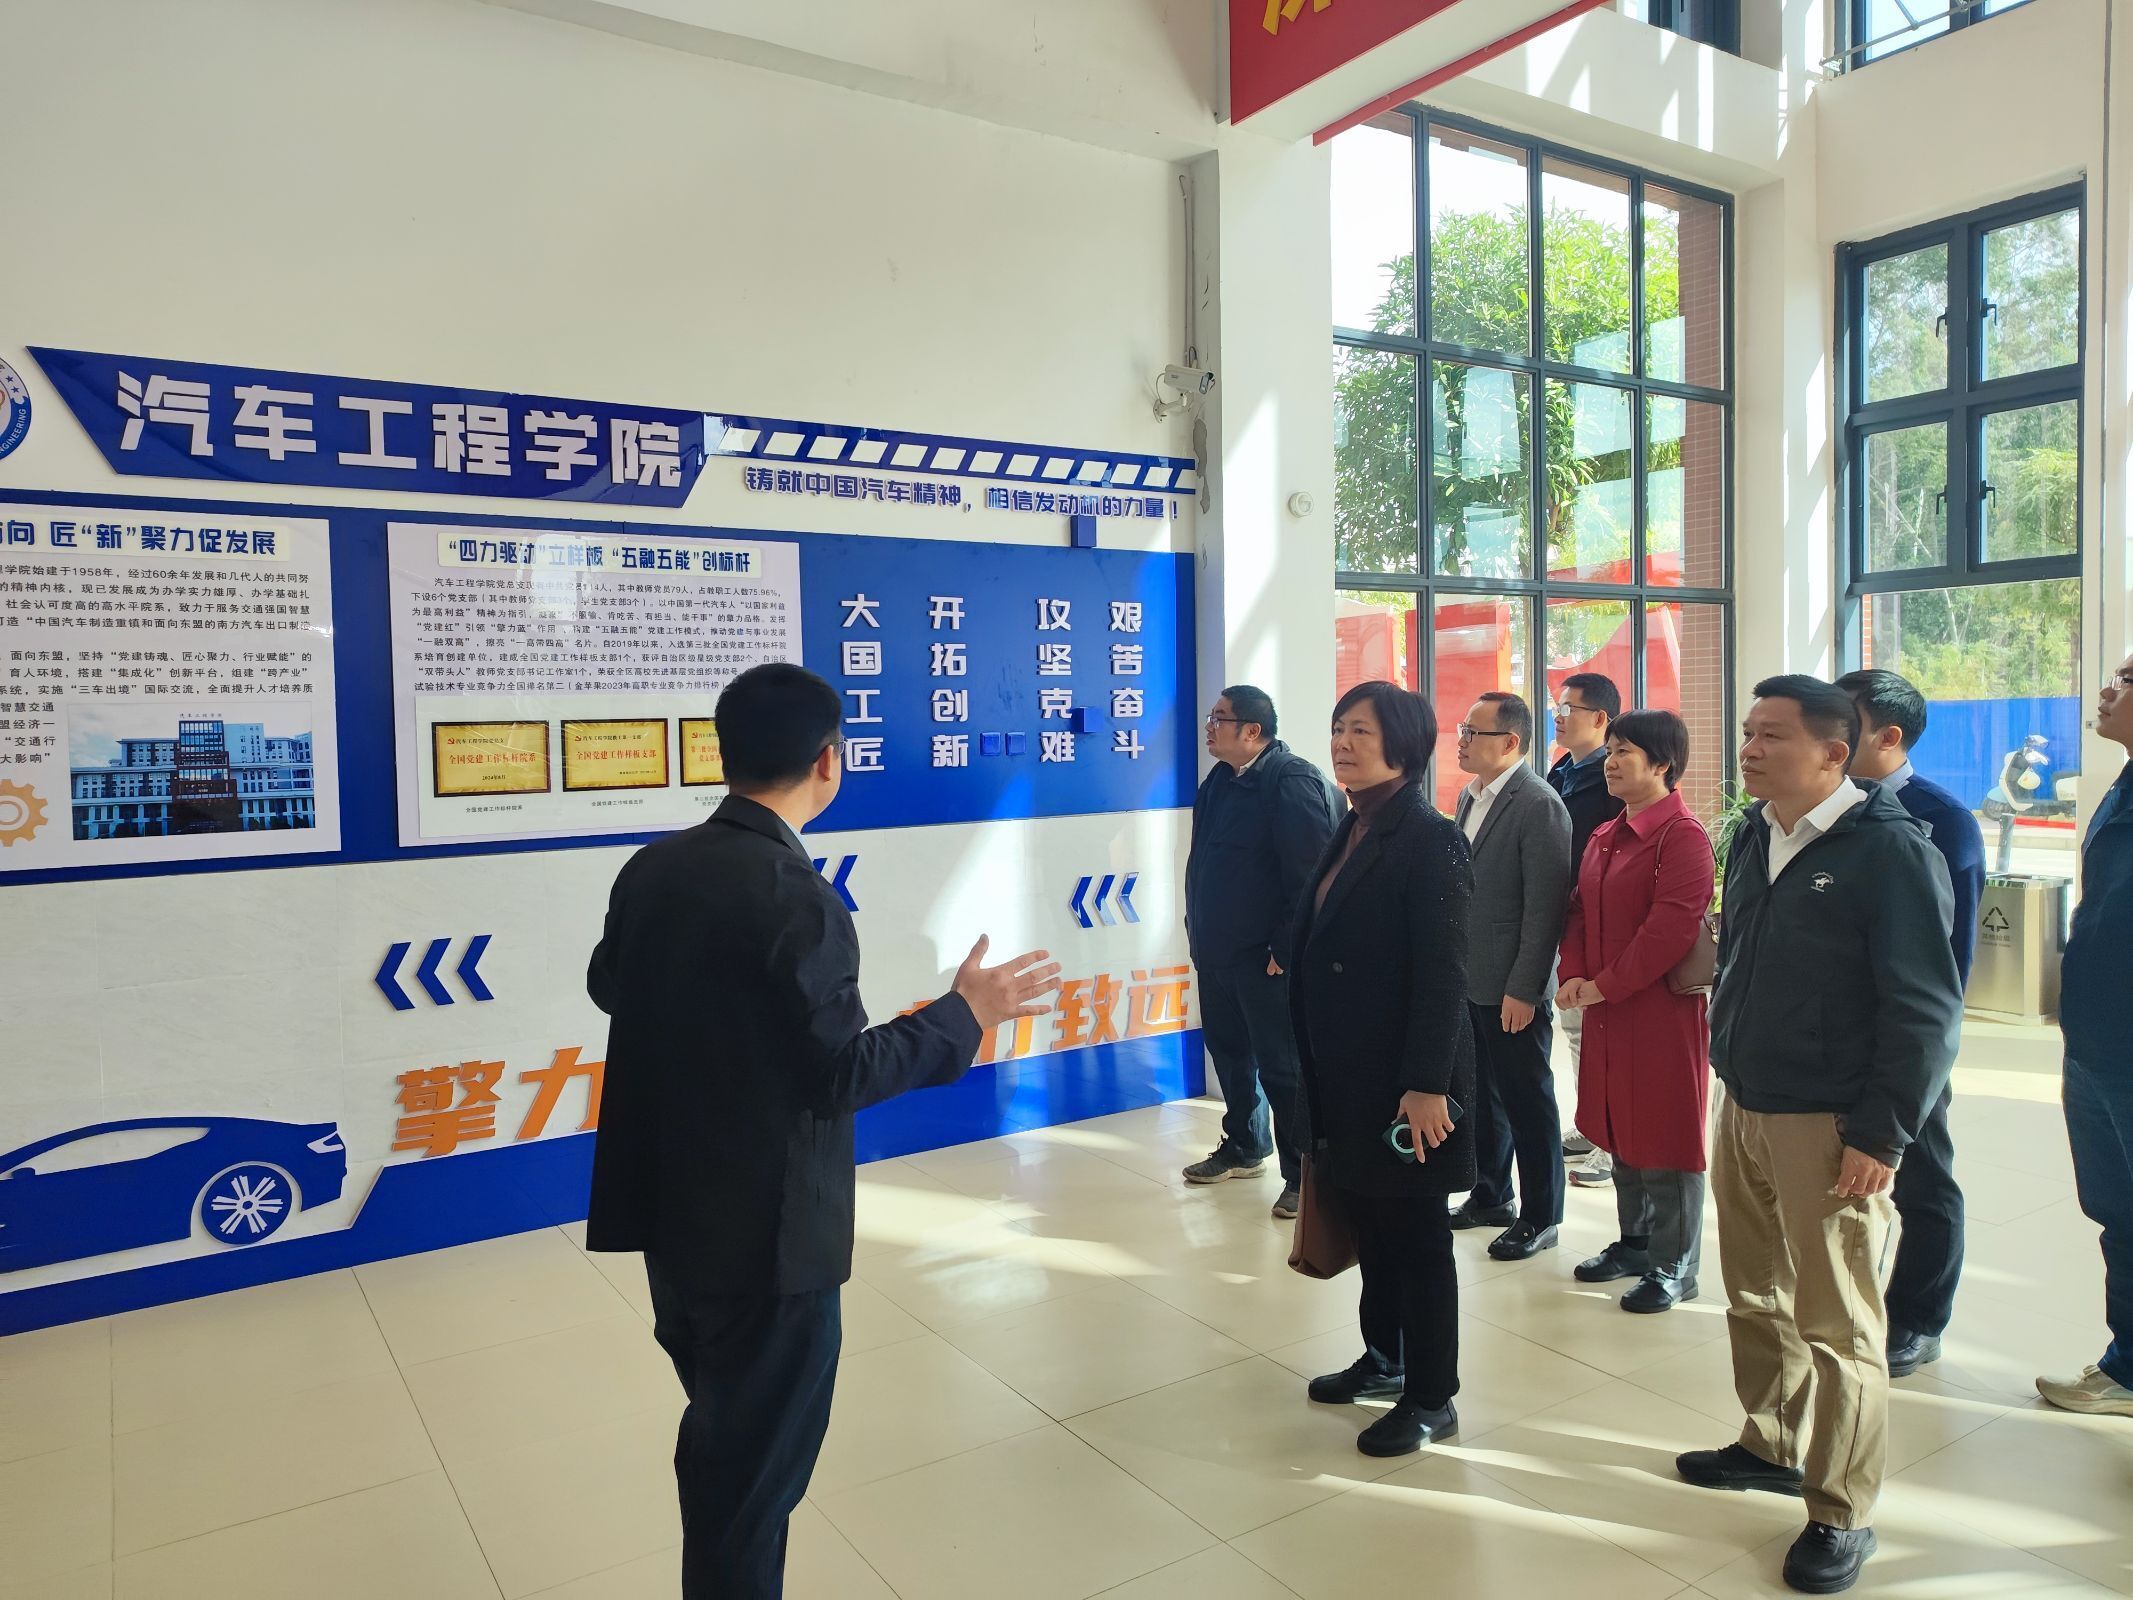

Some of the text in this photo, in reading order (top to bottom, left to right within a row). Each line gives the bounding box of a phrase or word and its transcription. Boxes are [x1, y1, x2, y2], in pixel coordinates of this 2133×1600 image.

[117, 370, 681, 488] 汽车工程学院
[0, 519, 35, 546] 向
[0, 564, 309, 584] 学院始建于1958年，经过60余年发展和几代人的共同努
[0, 616, 311, 631] 造“中国汽车制造重镇和面向东盟的南方汽车出口制造
[928, 595, 969, 768] 开拓创新
[1036, 598, 1075, 763] 攻坚克难
[1109, 601, 1145, 760] 艰苦奋斗
[1, 701, 54, 713] 智慧交通
[841, 593, 885, 772] 大国工匠
[391, 1045, 606, 1159] 擎力
